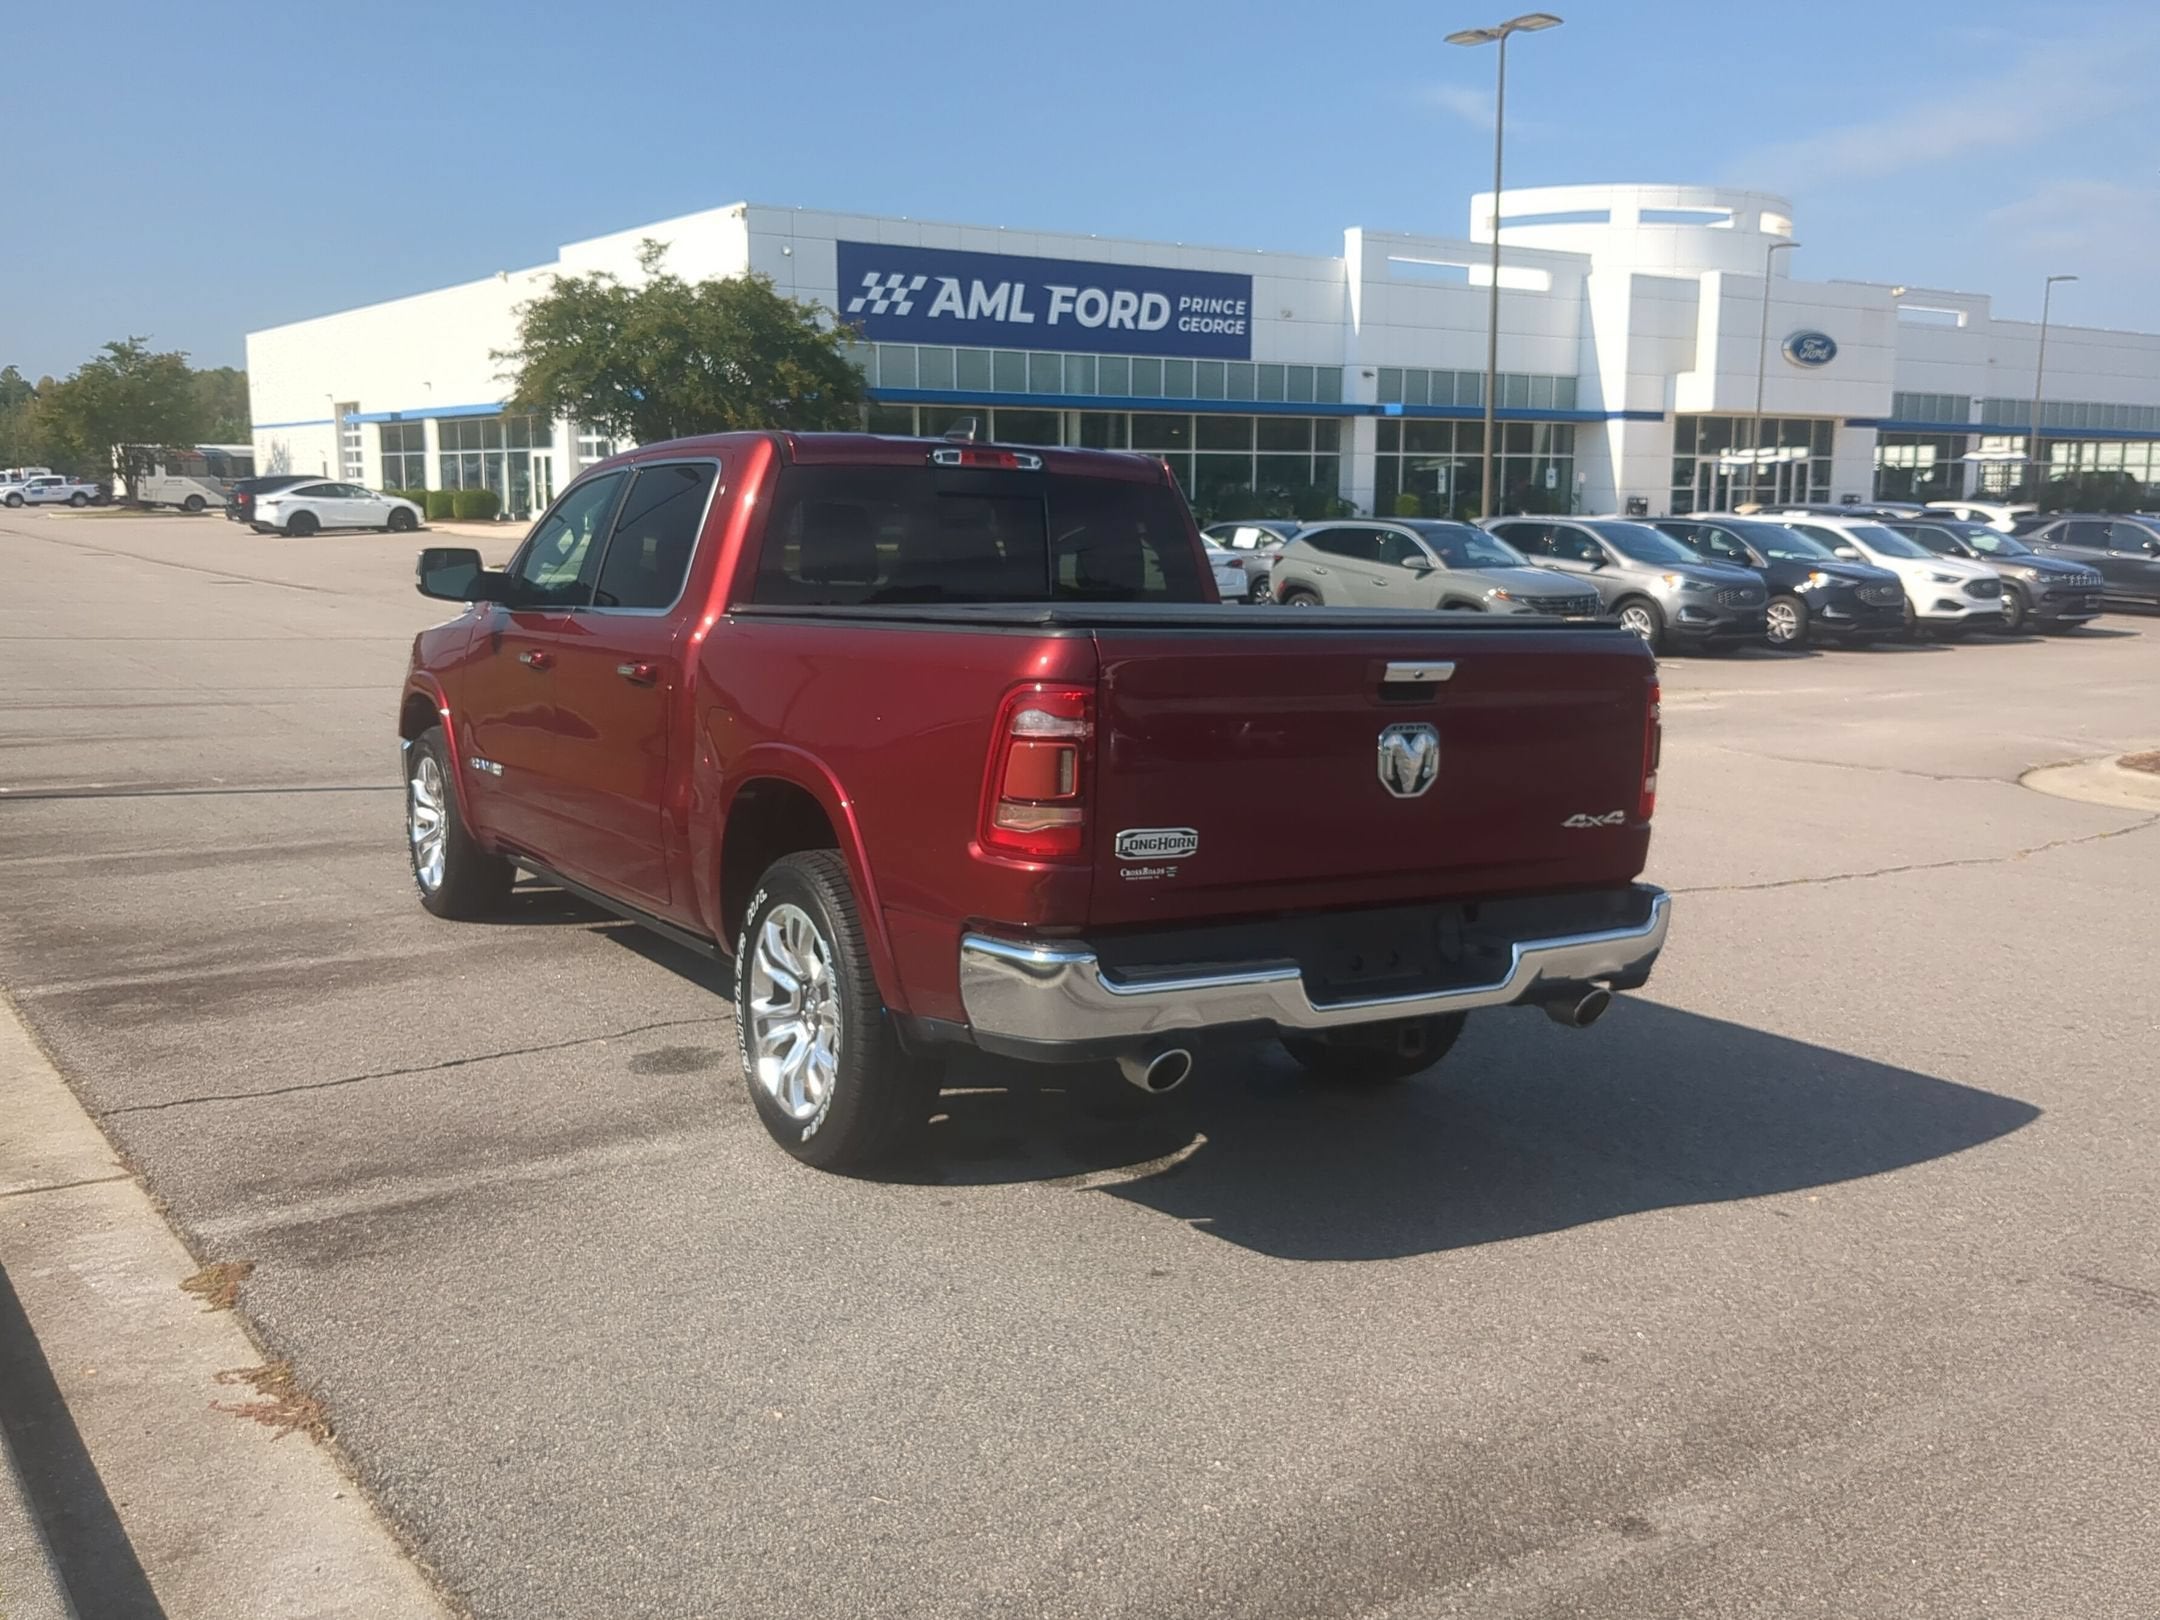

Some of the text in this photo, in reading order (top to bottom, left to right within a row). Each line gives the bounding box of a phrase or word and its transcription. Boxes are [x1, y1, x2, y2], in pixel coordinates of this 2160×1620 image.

[928, 276, 1171, 331] AML FORD
[1178, 296, 1247, 316] PRINCE
[1178, 316, 1246, 336] GEORGE
[1799, 339, 1831, 360] Ford
